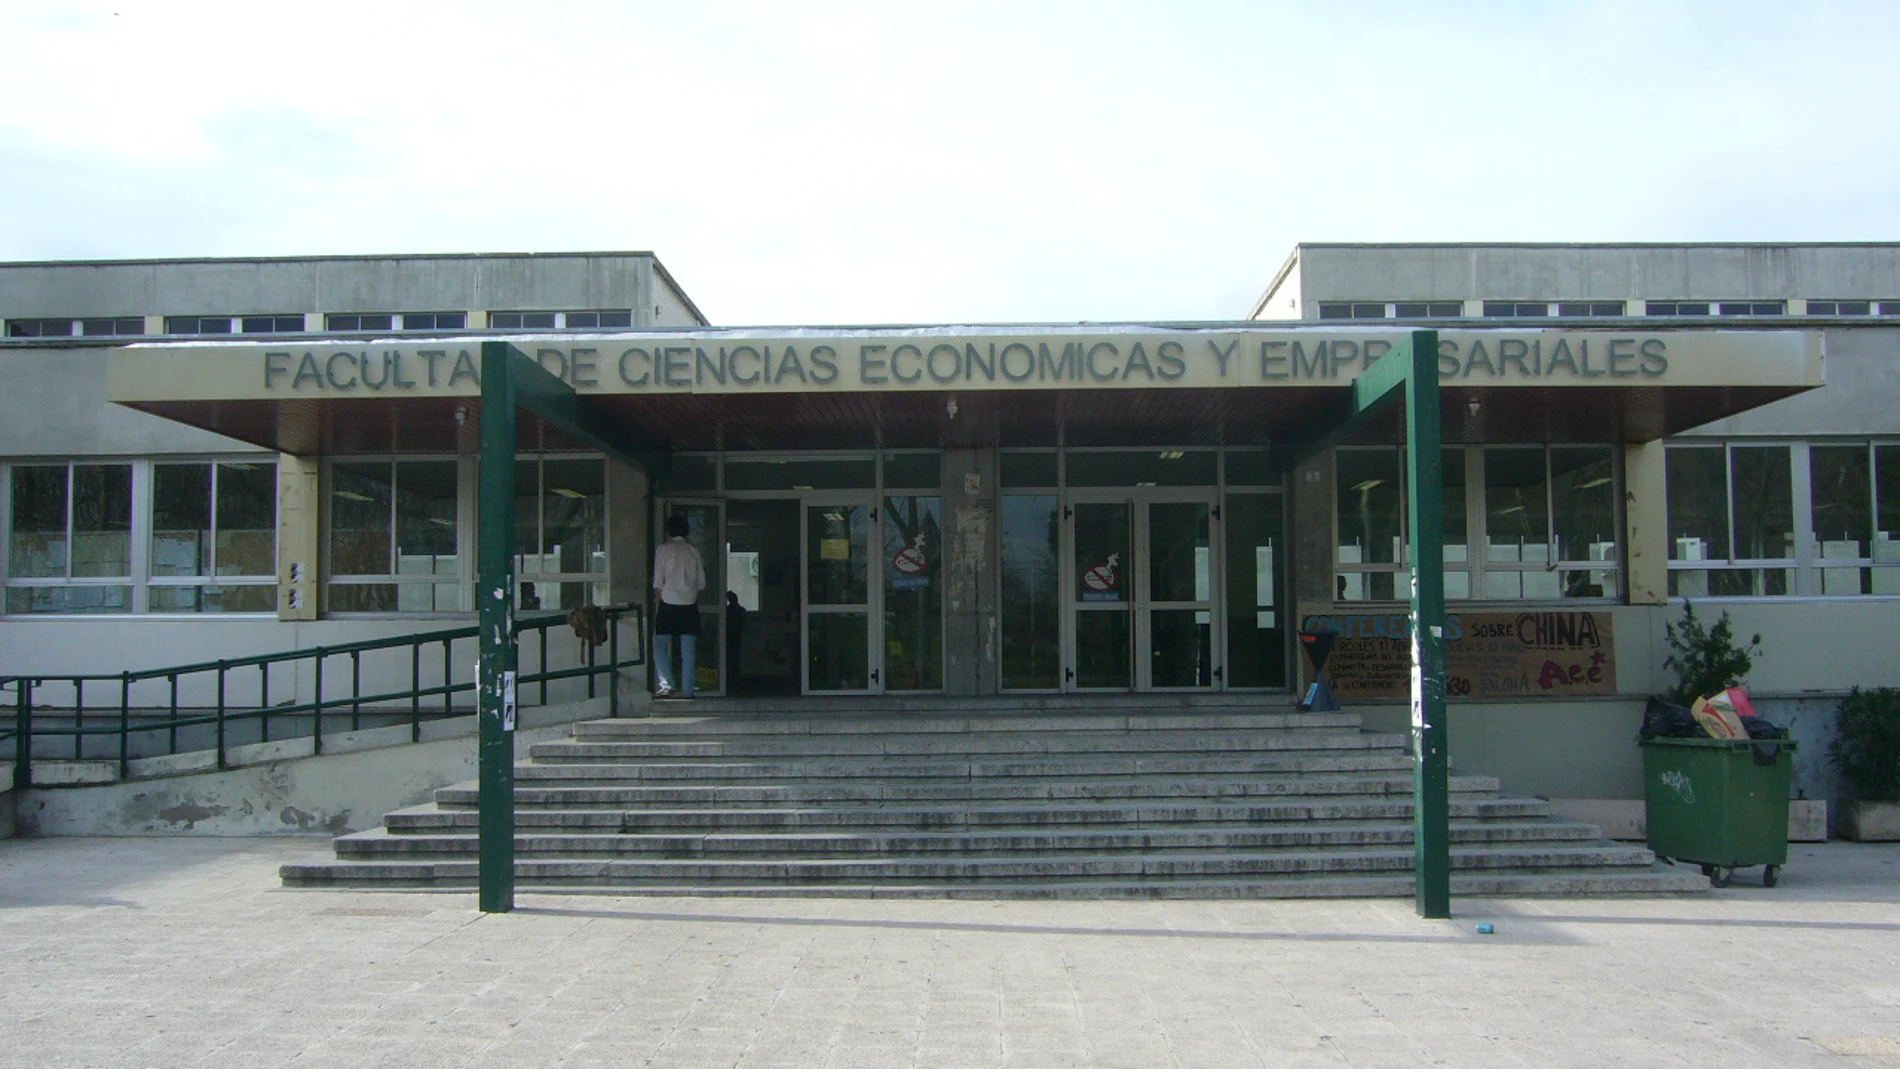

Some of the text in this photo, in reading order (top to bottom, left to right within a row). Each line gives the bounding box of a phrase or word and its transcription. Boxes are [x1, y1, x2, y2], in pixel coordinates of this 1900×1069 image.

[264, 350, 484, 390] FACULTA
[618, 346, 839, 387] CIENCIAS
[860, 340, 1187, 384] ECONOMICAS
[1207, 339, 1239, 378] Y
[1261, 338, 1668, 380] EMPRSARIALES
[1471, 623, 1513, 637] SOBRE
[1516, 611, 1600, 649] CHINA
